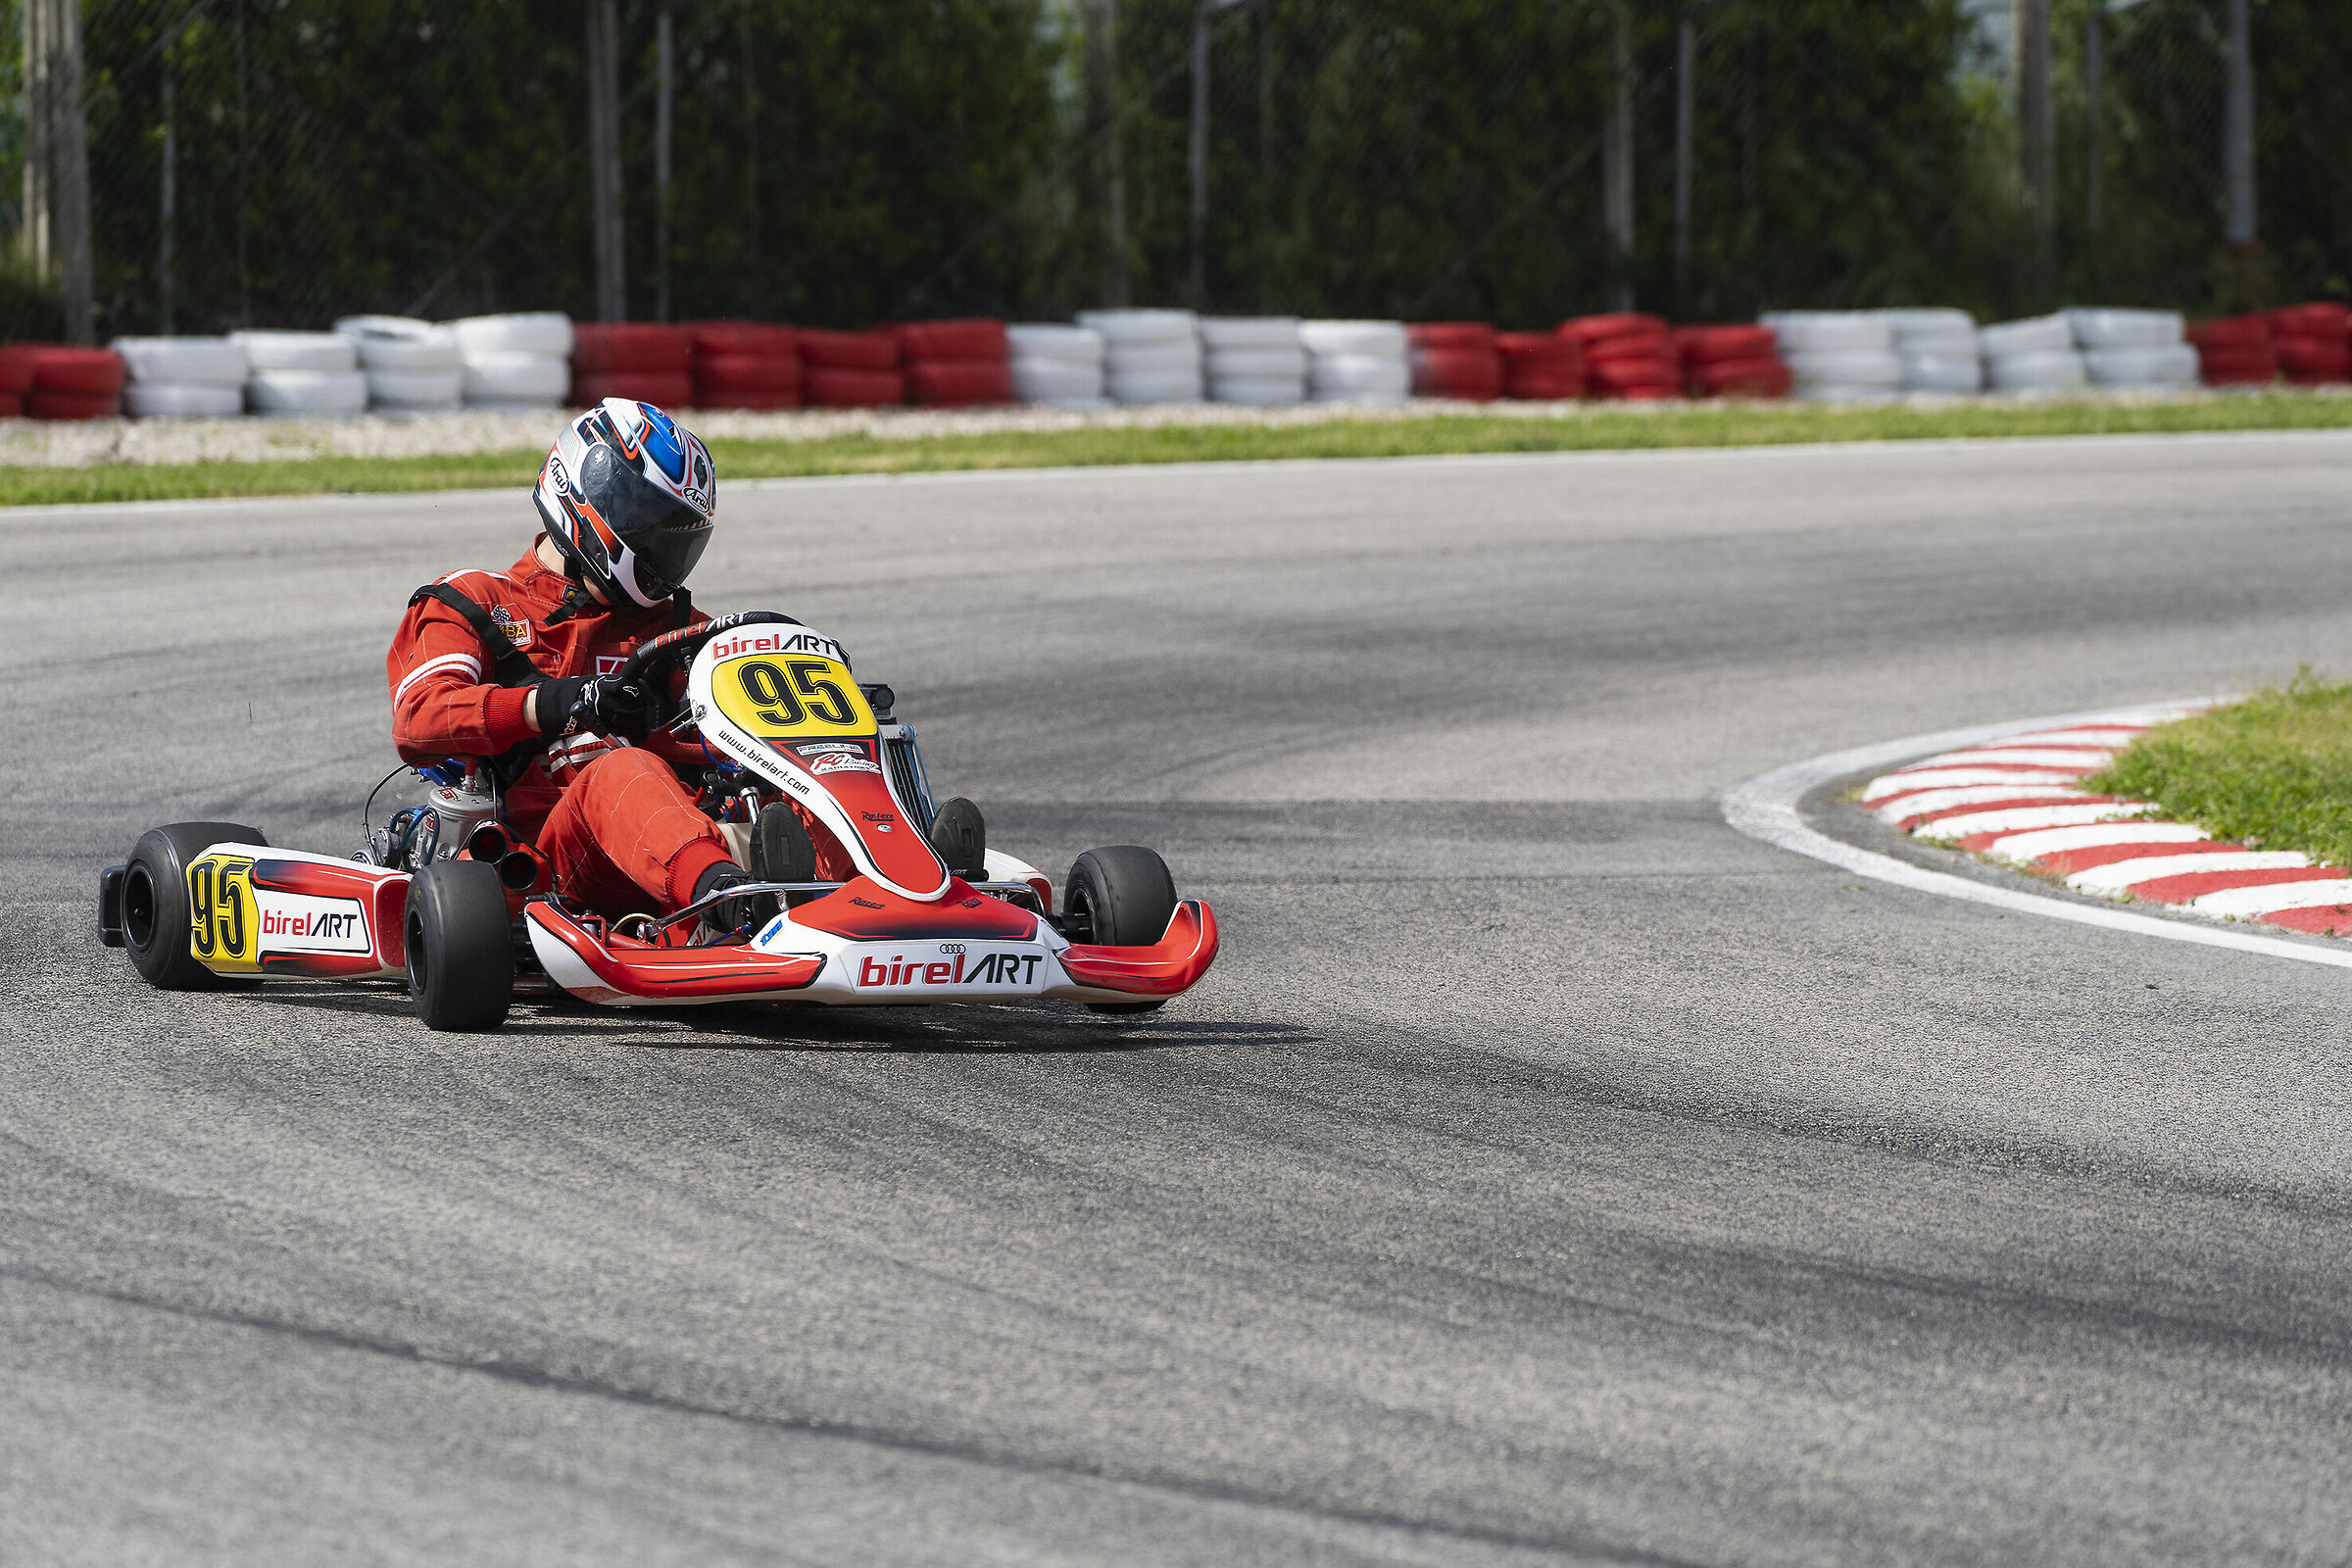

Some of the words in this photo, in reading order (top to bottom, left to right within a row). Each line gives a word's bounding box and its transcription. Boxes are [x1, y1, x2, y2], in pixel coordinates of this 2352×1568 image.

[550, 463, 568, 489] Arai
[711, 633, 833, 661] birelART
[737, 661, 858, 727] 95
[718, 729, 810, 796] www.birelart.com
[189, 858, 253, 958] 95
[263, 909, 358, 939] birelART
[858, 953, 1043, 988] birelART
